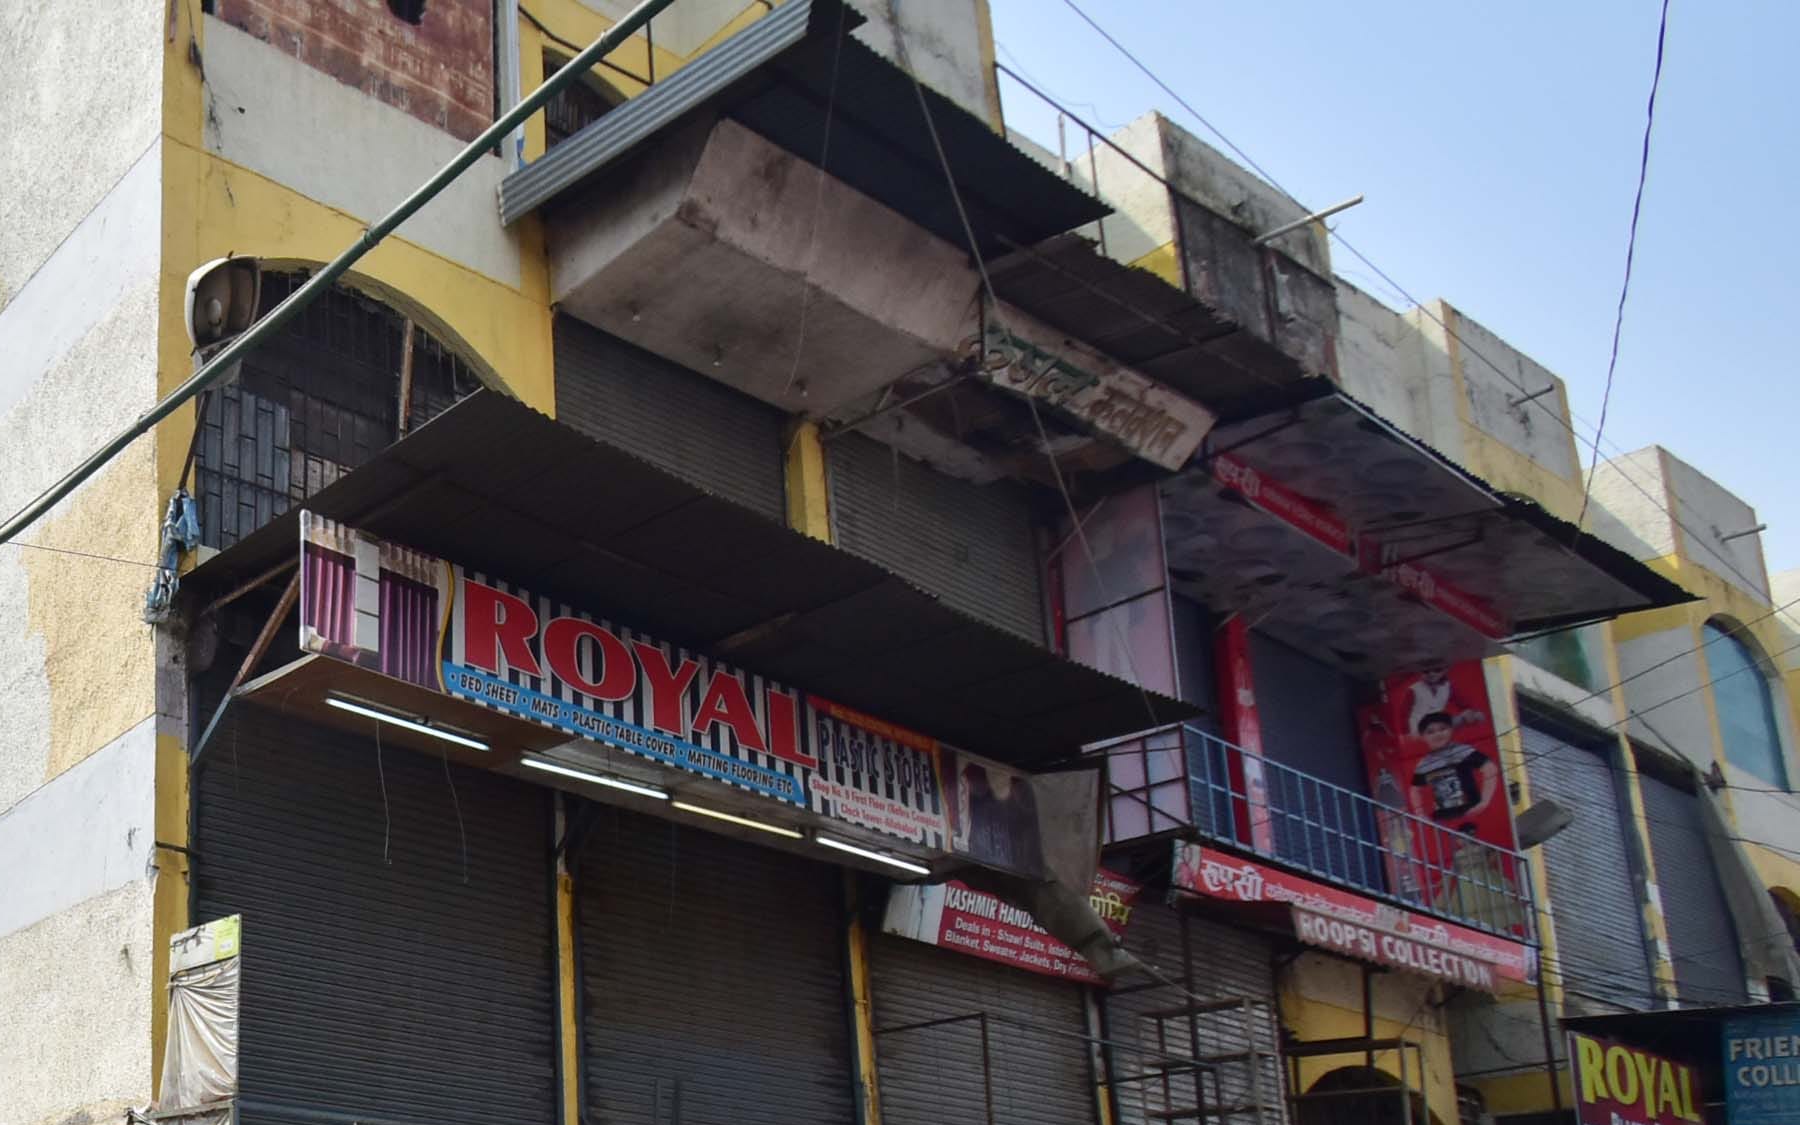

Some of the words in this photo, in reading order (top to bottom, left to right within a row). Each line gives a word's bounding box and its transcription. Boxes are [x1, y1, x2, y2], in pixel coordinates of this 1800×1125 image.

[460, 673, 482, 694] BED
[485, 682, 519, 705] SHEET
[463, 577, 819, 770] ROYAL
[531, 695, 560, 718] MATS
[572, 709, 612, 737] PLASTIC
[614, 723, 643, 746] TABLE
[646, 735, 676, 758] COVER
[818, 720, 880, 779] PLASTIC
[687, 750, 729, 774] MATTING
[731, 763, 775, 789] FLOORING
[776, 778, 794, 794] ETC
[945, 886, 999, 920] KASHMIR
[955, 916, 980, 934] Deals
[1299, 914, 1377, 957] ROOPSI
[1382, 936, 1492, 986] COLLECTION
[1576, 1035, 1700, 1123] ROYAL
